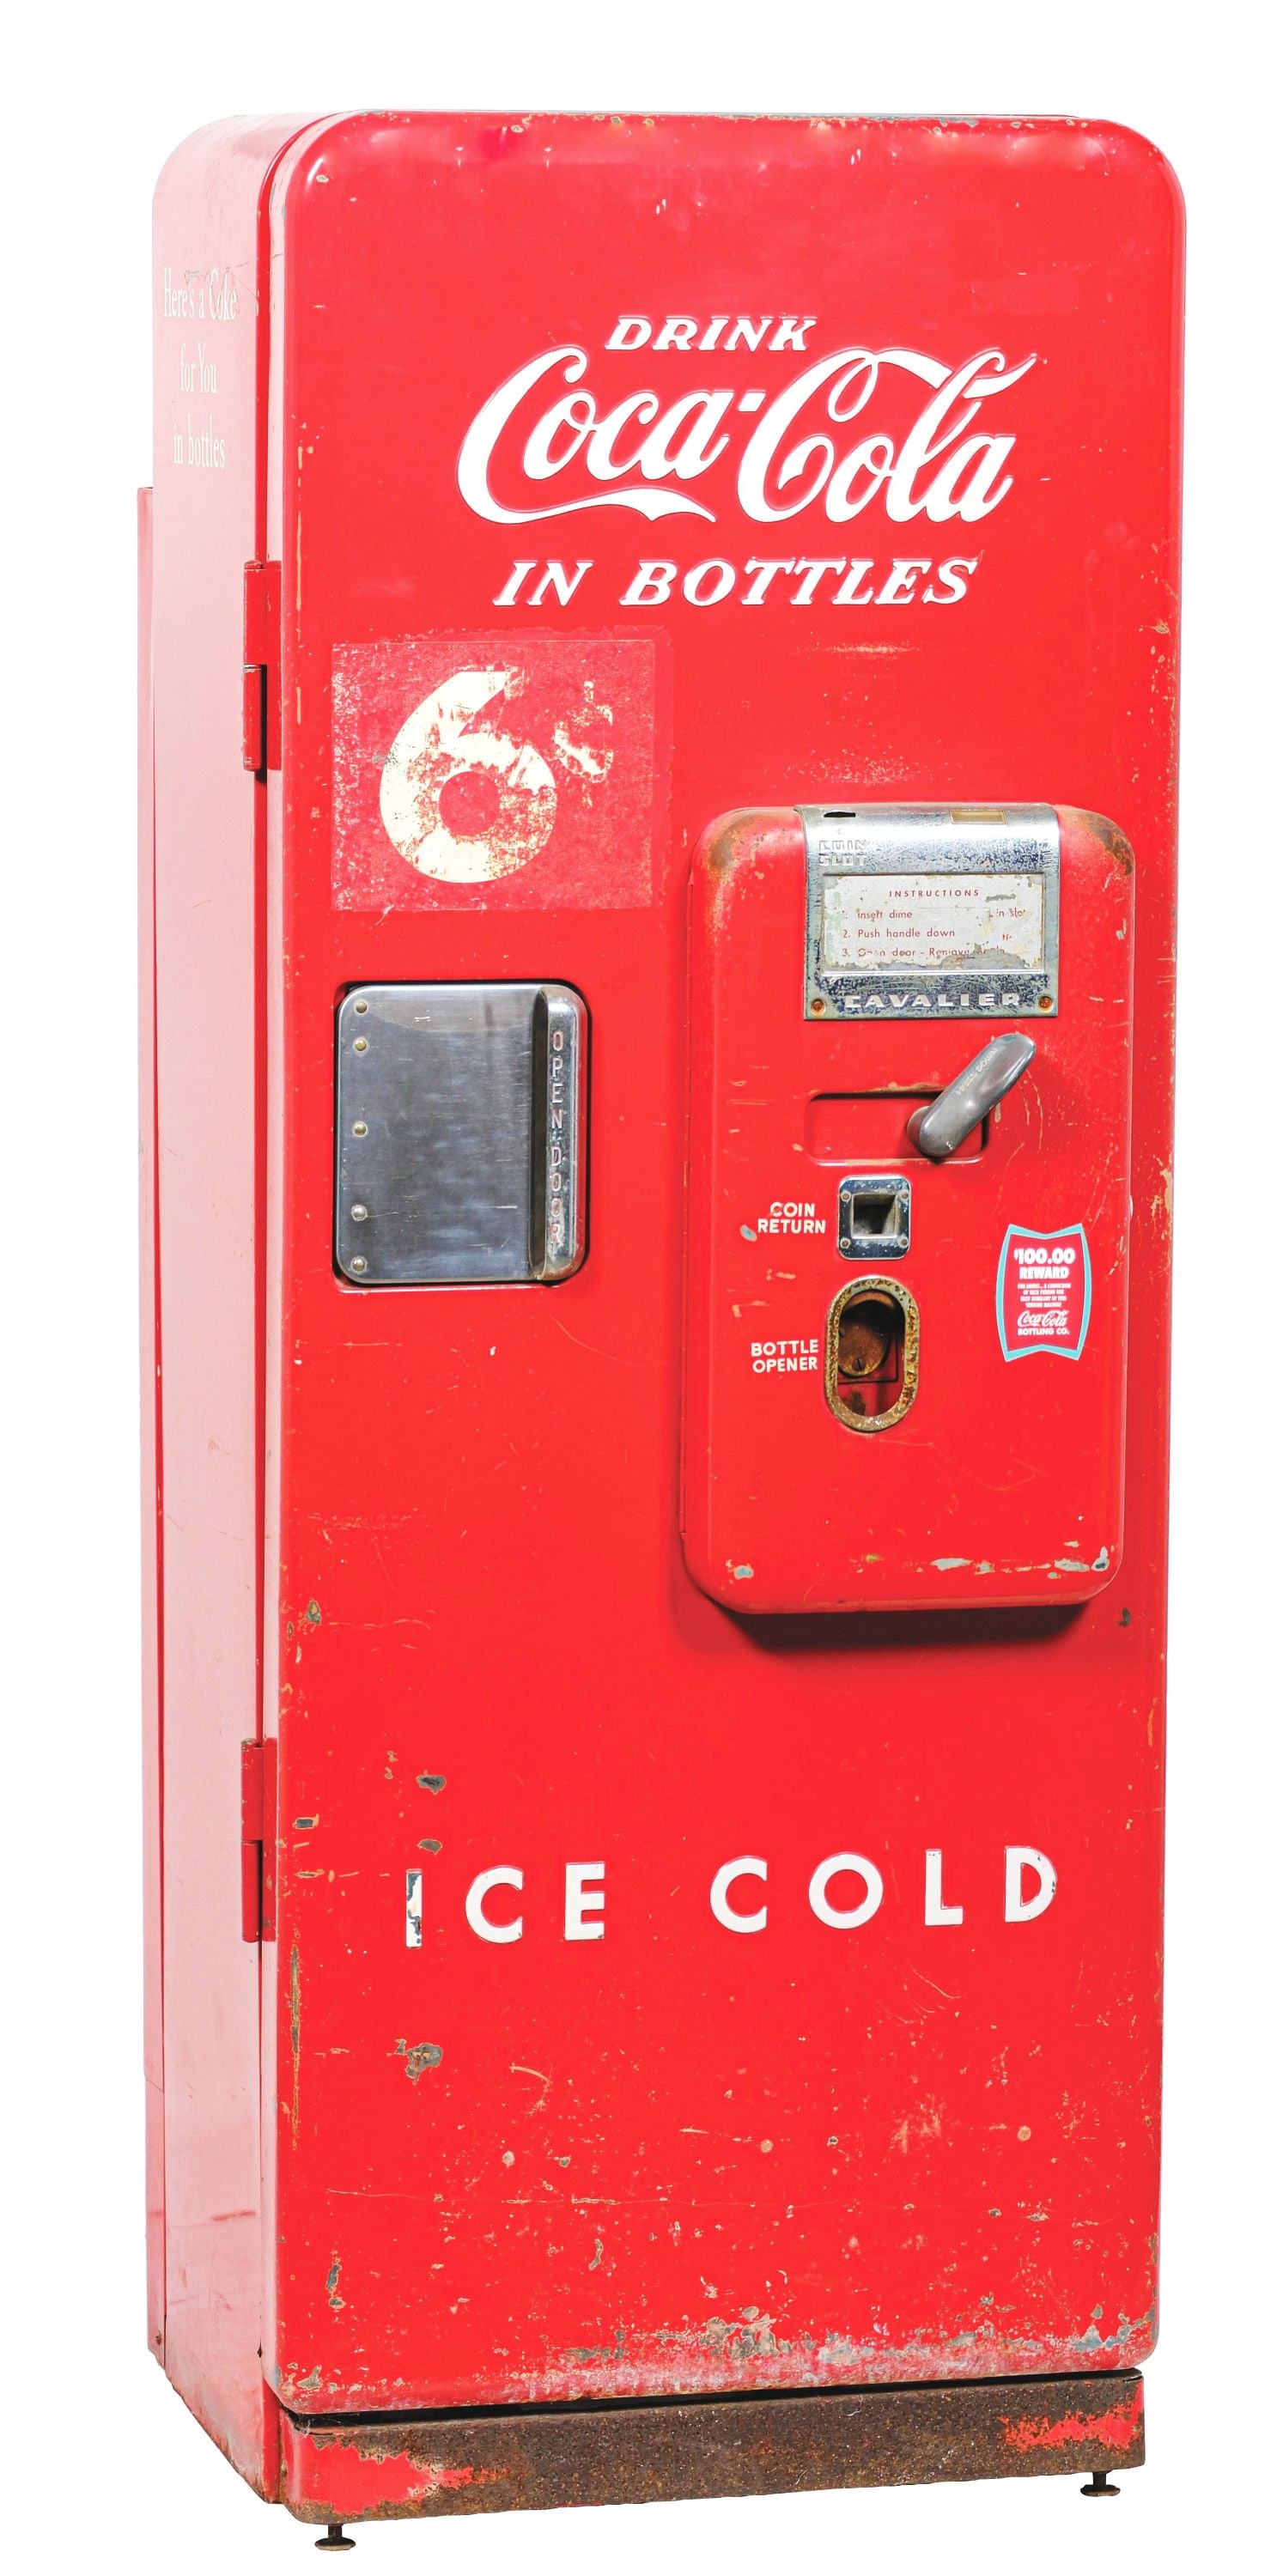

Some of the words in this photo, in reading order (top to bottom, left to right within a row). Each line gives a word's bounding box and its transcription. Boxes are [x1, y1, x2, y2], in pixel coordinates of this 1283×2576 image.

[163, 267, 195, 318] Here's
[198, 287, 205, 319] a
[209, 268, 237, 321] Coke
[605, 315, 818, 351] DRINK
[180, 342, 196, 392] for
[198, 342, 218, 394] You
[173, 424, 184, 465] in
[187, 413, 226, 469] bottles
[456, 344, 1037, 525] Coca-Cola
[491, 559, 593, 606] IN
[618, 556, 979, 606] BOTTLES
[818, 854, 867, 866] SLOT
[889, 889, 980, 898] INSTRUCTIONS
[889, 909, 913, 919] dime
[842, 929, 851, 938] 2.
[858, 928, 880, 938] Push
[886, 927, 921, 938] handle
[927, 927, 955, 938] down
[842, 948, 850, 957] 3.
[892, 947, 915, 957] door
[843, 993, 1021, 1009] CAVALIER
[550, 1030, 563, 1130] OPEN
[550, 1146, 563, 1244] DOOR
[769, 1202, 816, 1218] COIN
[757, 1218, 826, 1234] RETURN
[1019, 1266, 1070, 1279] REWARD
[1017, 1309, 1069, 1327] Coca-Cola
[1018, 1327, 1055, 1336] BOTTLING
[751, 1339, 819, 1357] BOTTLE
[752, 1357, 818, 1374] OPENER
[405, 1860, 605, 1948] ICE
[708, 1844, 1059, 1935] COLD
